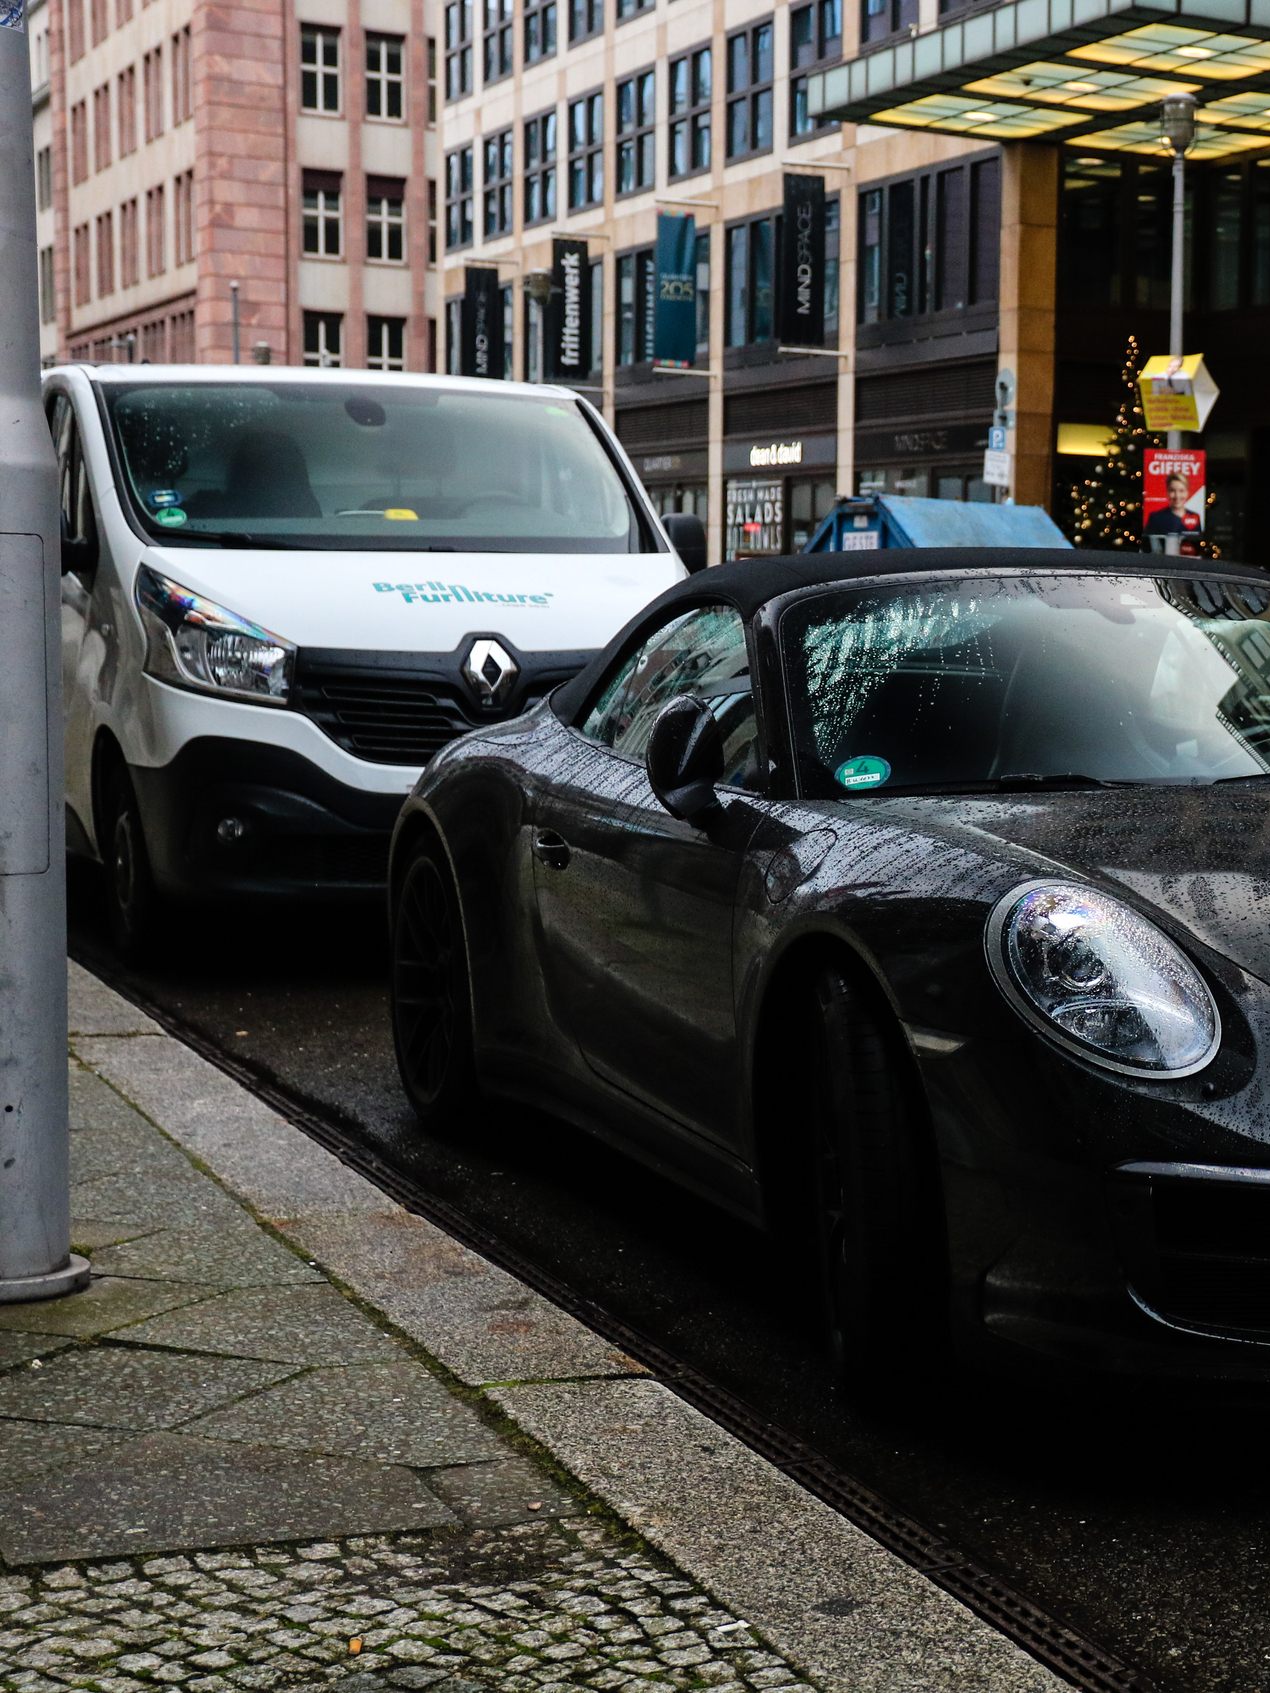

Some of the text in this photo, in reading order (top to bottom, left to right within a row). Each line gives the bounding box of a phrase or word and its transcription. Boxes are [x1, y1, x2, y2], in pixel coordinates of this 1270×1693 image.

[561, 251, 580, 366] frittenwerk
[1154, 453, 1195, 461] FRANZISKA
[1148, 461, 1201, 475] GIFFEY
[727, 486, 782, 503] FRESH MADE
[726, 501, 782, 525] SALADS
[856, 761, 869, 773] 4
